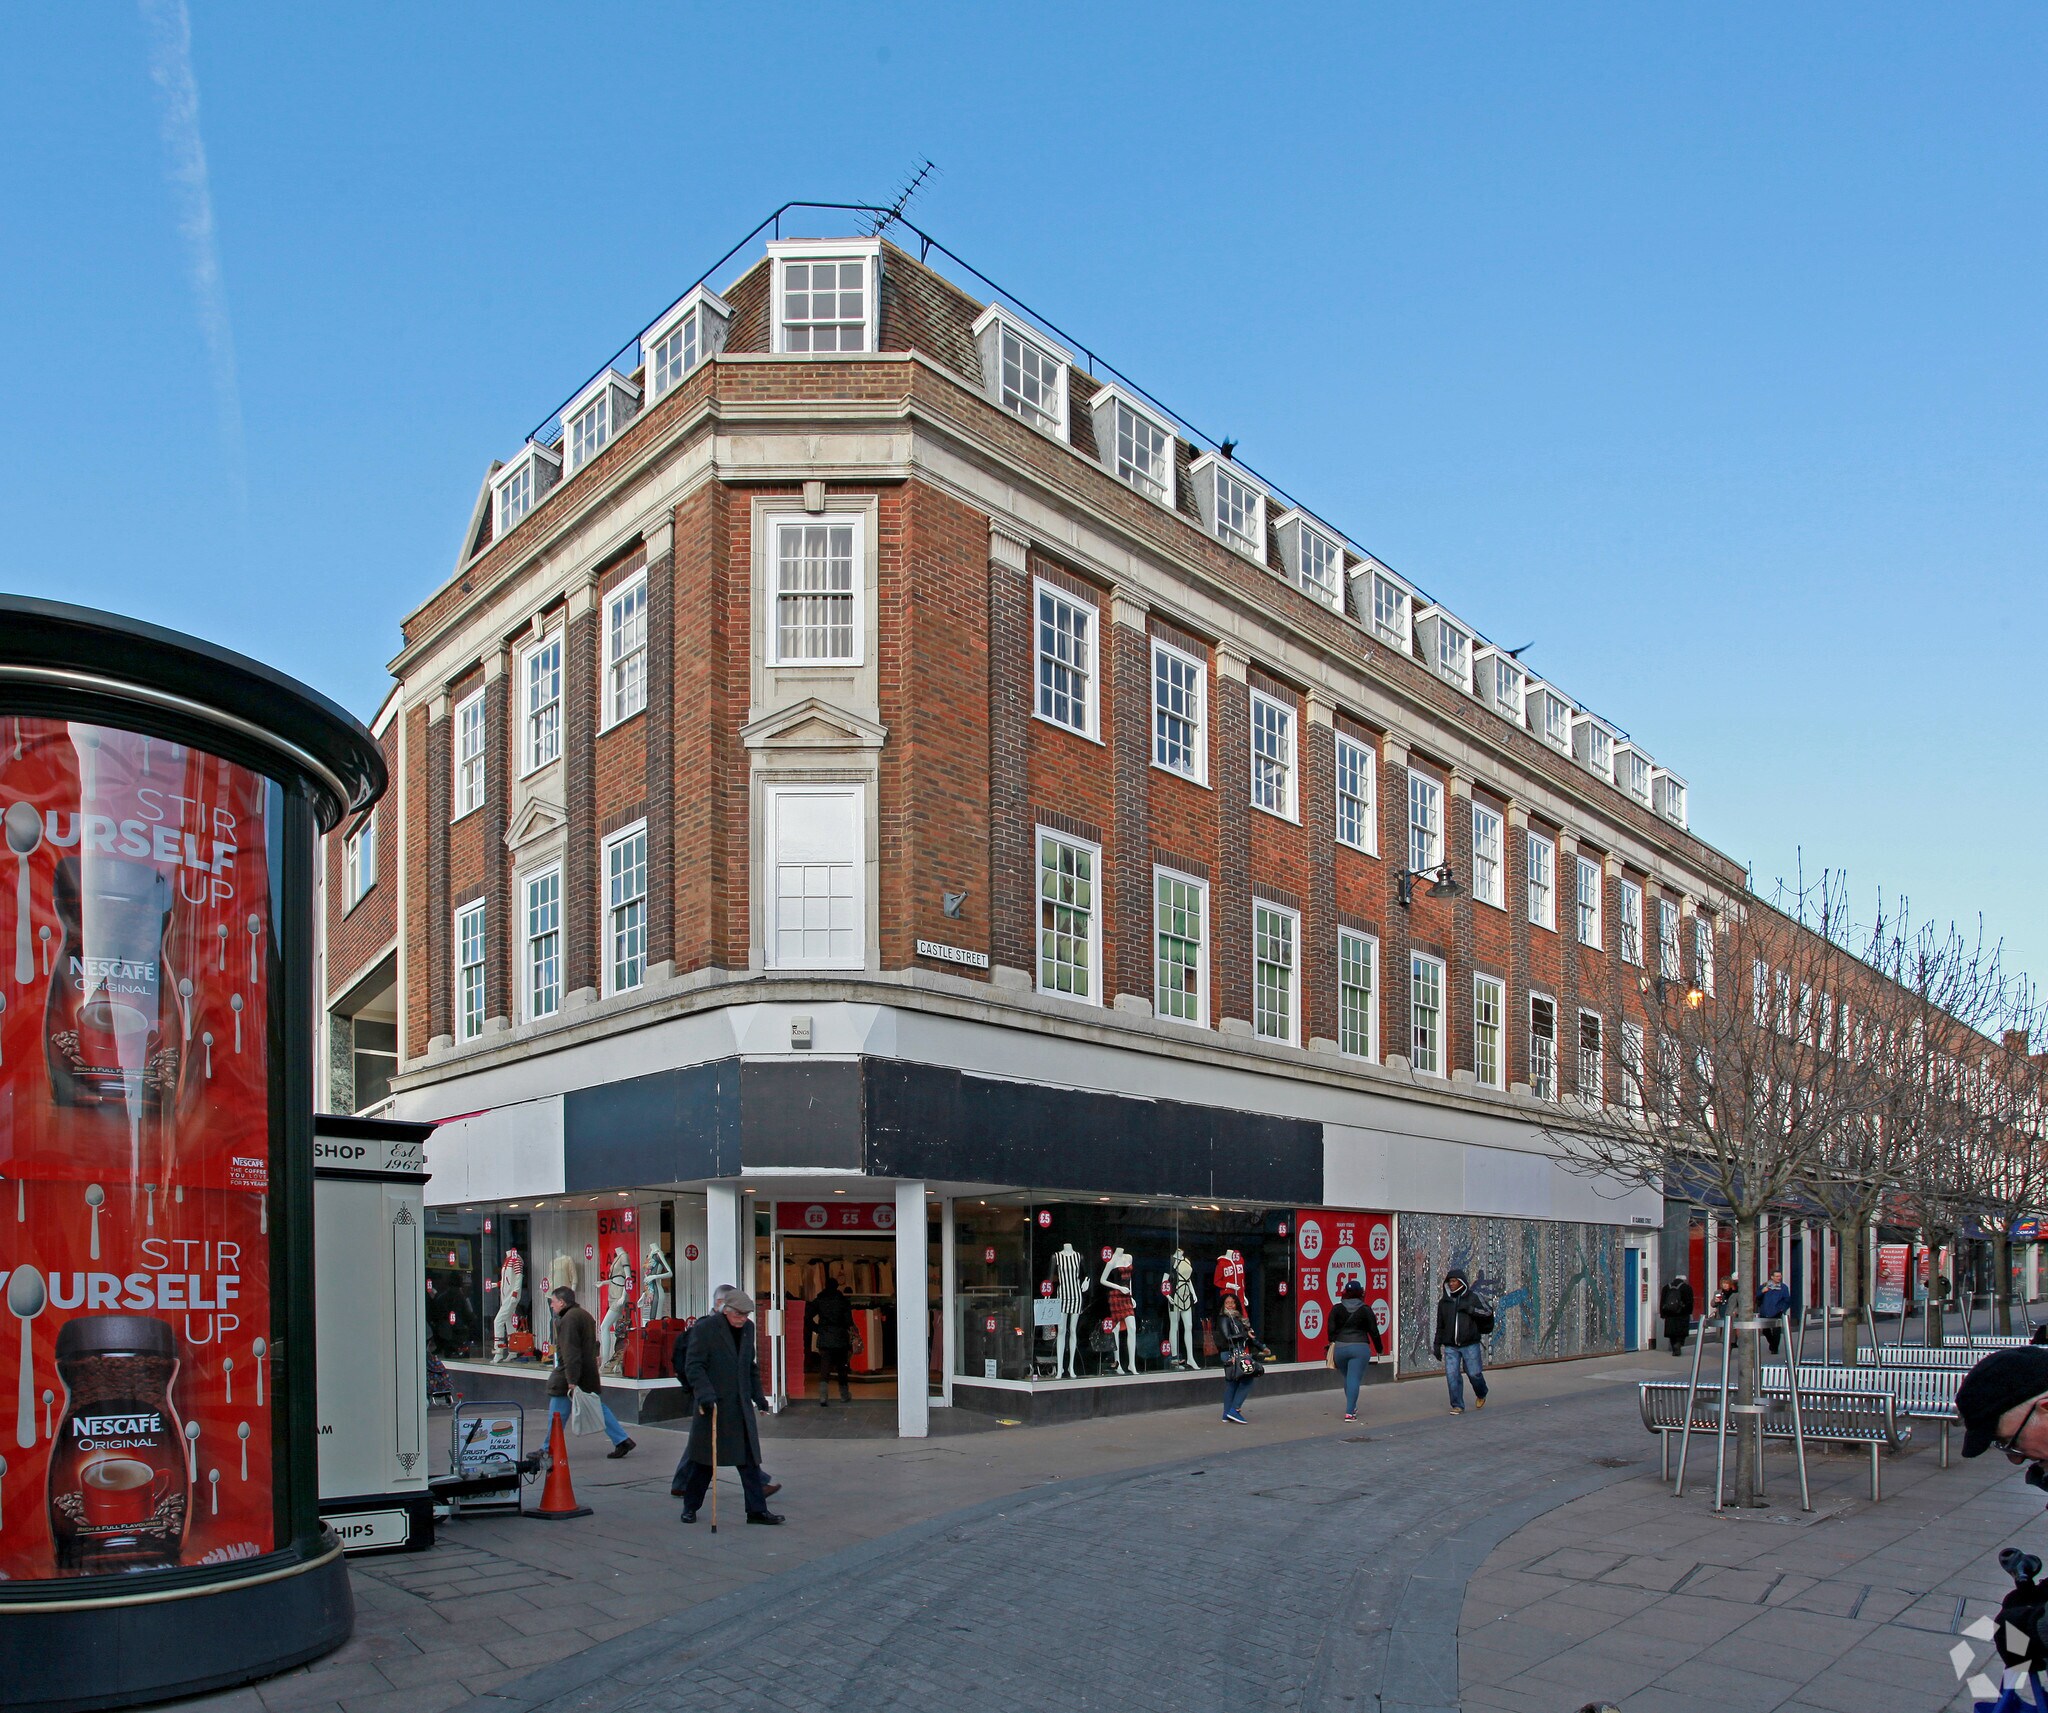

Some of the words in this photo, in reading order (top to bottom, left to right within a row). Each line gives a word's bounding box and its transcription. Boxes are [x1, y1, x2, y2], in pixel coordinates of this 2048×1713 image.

[136, 787, 237, 843] STIR
[180, 869, 234, 909] UP
[920, 942, 953, 960] CASTLE
[955, 950, 986, 966] STREET
[69, 955, 156, 982] NESCAFÉ
[74, 978, 152, 996] ORIGINAL
[74, 1065, 92, 1073] RICH
[101, 1066, 116, 1074] FULL
[315, 1143, 366, 1160] SHOP
[390, 1143, 416, 1158] Est
[232, 1156, 264, 1168] NESCAFÉ
[384, 1159, 422, 1172] 1967
[1039, 1213, 1050, 1223] £5
[1278, 1224, 1286, 1234] £5
[1304, 1235, 1318, 1250] £5
[1339, 1228, 1354, 1245] £5
[1373, 1237, 1386, 1251] £5
[140, 1238, 240, 1272] STIR
[985, 1249, 994, 1260] £5
[1102, 1249, 1112, 1259] £5
[625, 1280, 633, 1290] £5
[1041, 1282, 1052, 1293] £5
[1161, 1283, 1171, 1292] £5
[1278, 1283, 1286, 1293] £5
[1303, 1274, 1319, 1291] £5
[1372, 1273, 1387, 1290] £5
[185, 1313, 240, 1345] UP
[986, 1319, 996, 1330] £5
[1103, 1320, 1113, 1330] £5
[1304, 1315, 1319, 1330] £5
[1162, 1343, 1171, 1353] £5
[73, 1412, 162, 1437] NESCAFÉ
[78, 1438, 158, 1452] ORIGINAL
[76, 1524, 95, 1532] RICH
[95, 1523, 101, 1531] &
[102, 1522, 120, 1531] FULL
[121, 1520, 162, 1530] FLAVOURED
